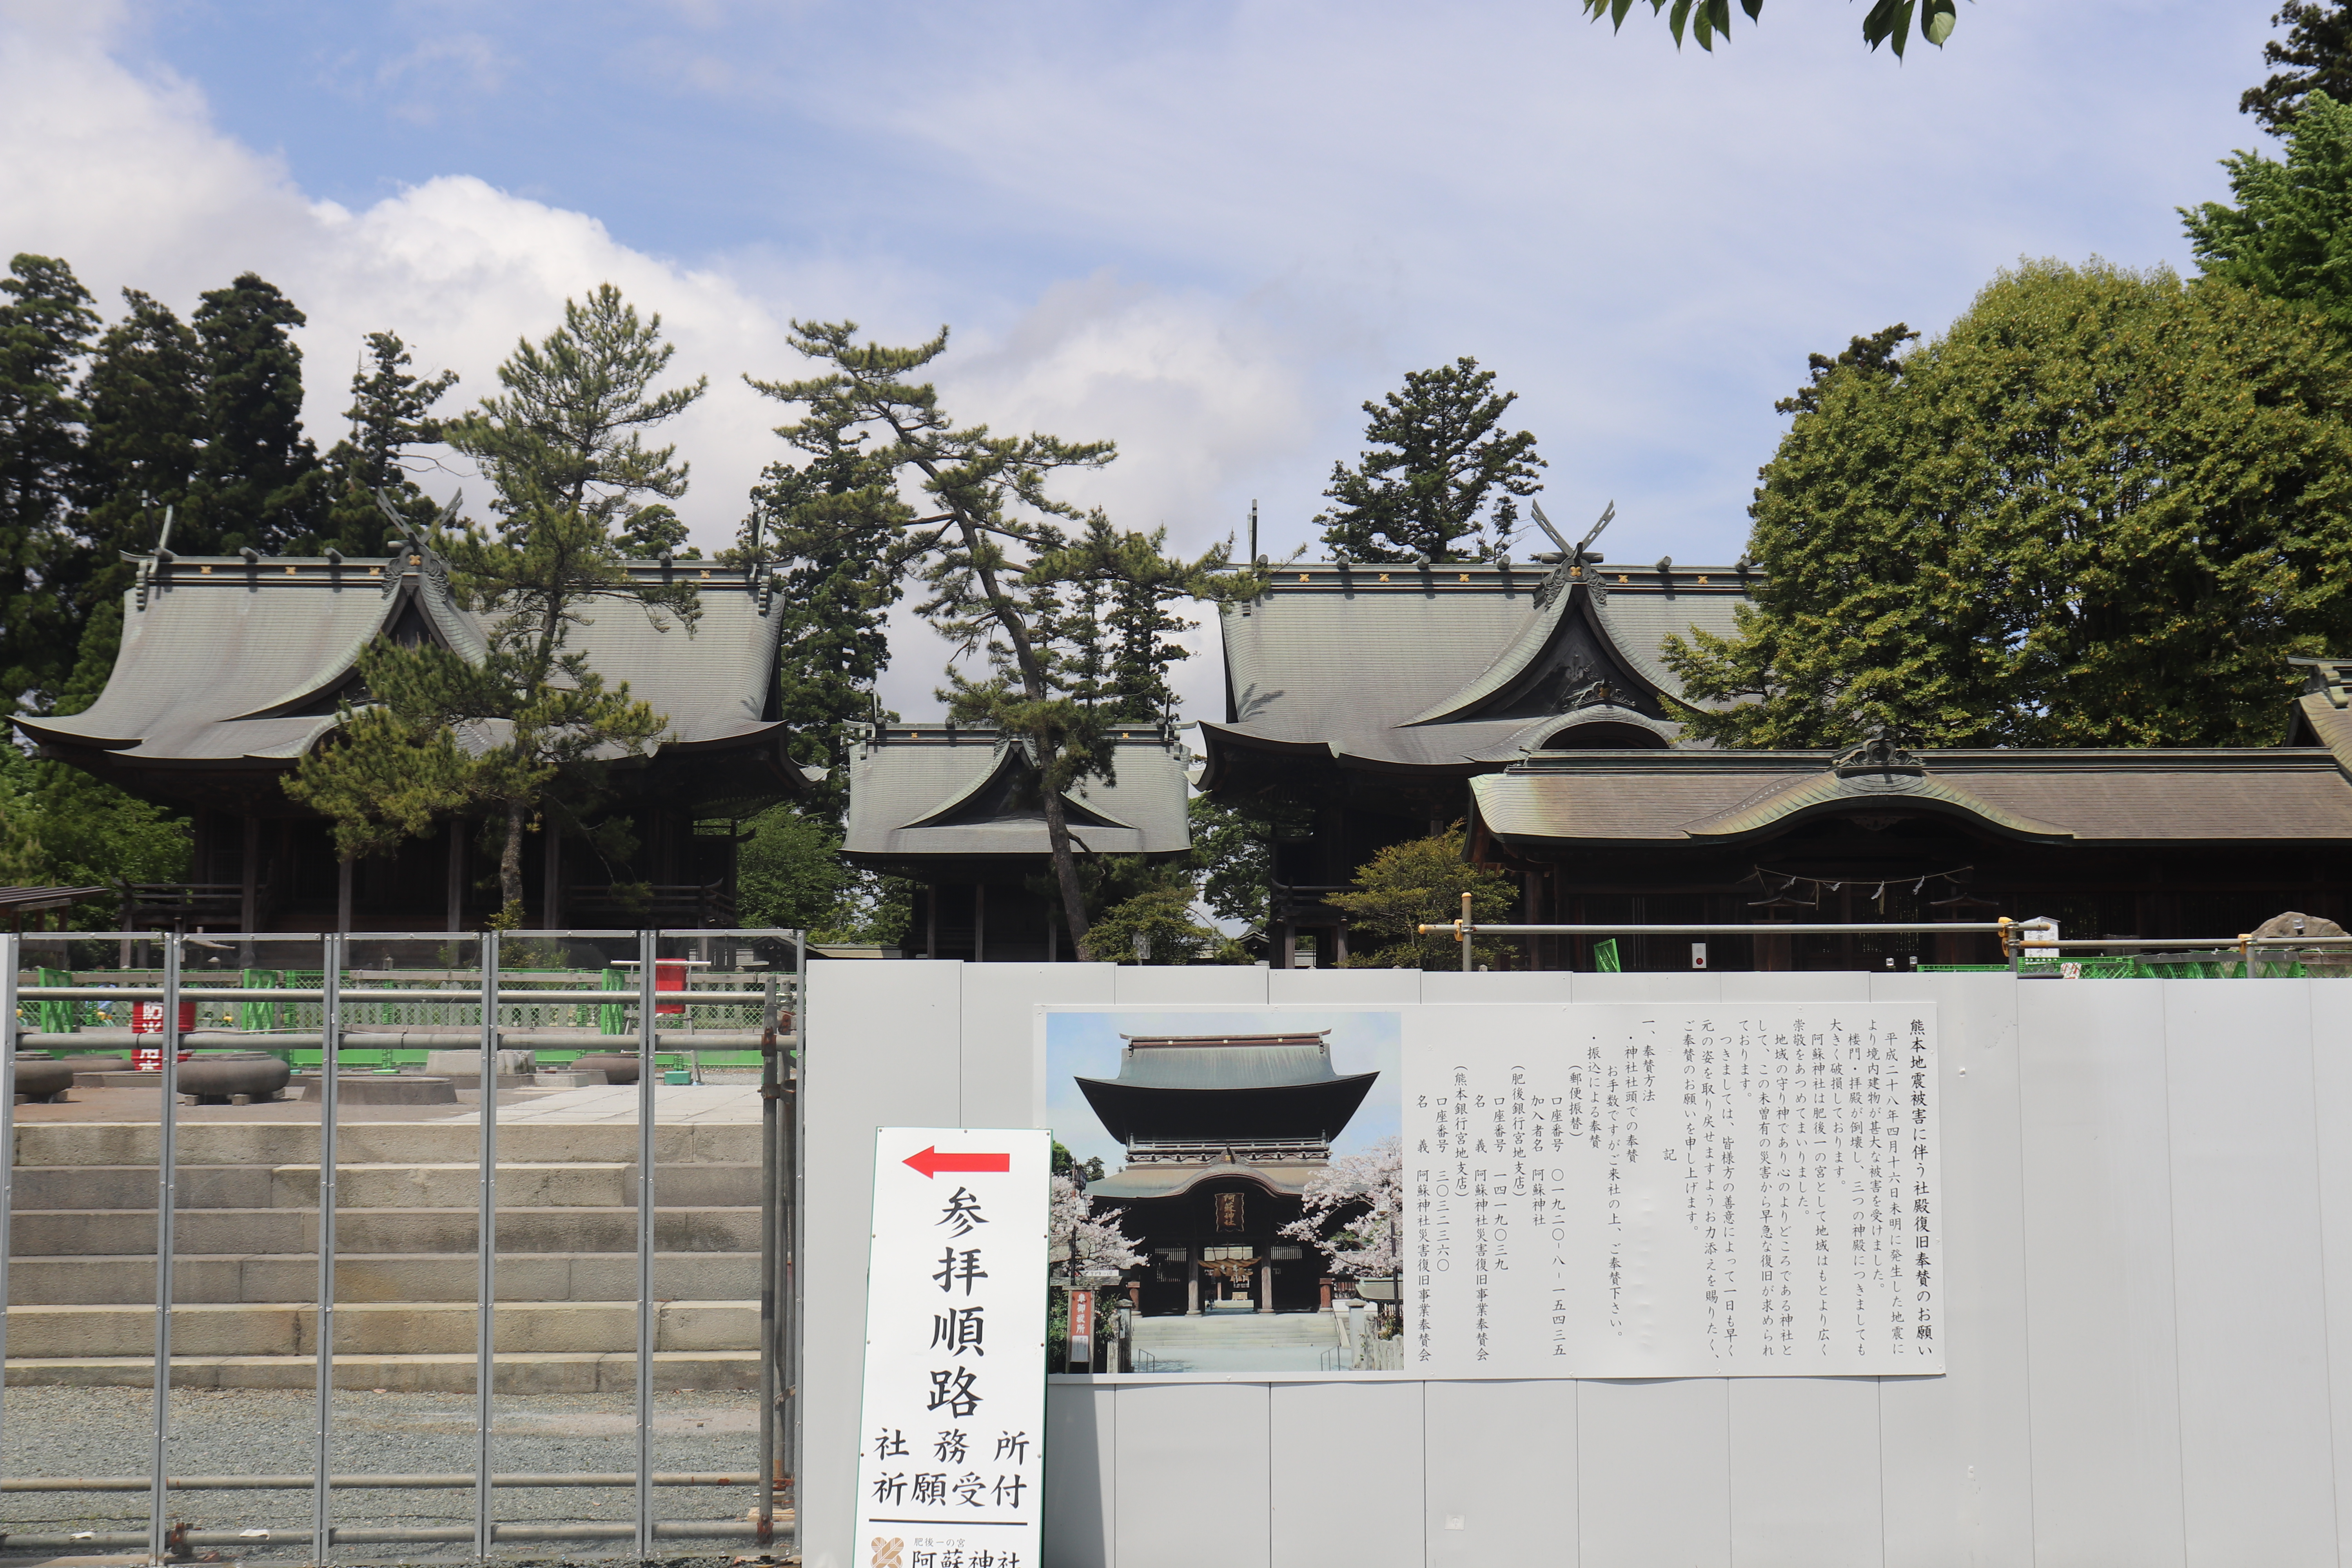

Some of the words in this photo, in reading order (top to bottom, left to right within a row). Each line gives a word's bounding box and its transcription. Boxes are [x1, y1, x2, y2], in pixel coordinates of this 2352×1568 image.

[1531, 1095, 1545, 1152] 加入者名
[1568, 1065, 1583, 1136] （郵便振替）
[1739, 1020, 1751, 1097] ております。
[1793, 1018, 1809, 1214] 崇敬をあつめてまいりました。
[1830, 1018, 1846, 1185] 大きく破損しております。
[1436, 1098, 1449, 1153] 口座番号
[1454, 1066, 1469, 1197] （熊本銀行宮地支店）
[1494, 1097, 1506, 1153] 口座番号
[1511, 1065, 1527, 1196] （肥後銀行宮地支店）
[1551, 1097, 1564, 1152] 口座番号
[1663, 1148, 1677, 1161] 記
[1683, 1020, 1698, 1230] ご奉賛のお願いを申し上げます。
[1701, 1019, 1719, 1358] 元の姿を取り戻せますようお力添えを賜りたく、
[1866, 1019, 1884, 1288] より境内建物が甚大な被害を受けました。
[1910, 1019, 1933, 1355] 熊本地震被害に伴う社殿復旧奉賛のお願い
[1436, 1171, 1450, 1272] 三〇三二三六〇
[1494, 1174, 1508, 1270] 一四一九〇三九
[1532, 1169, 1546, 1226] 阿蘇神社
[1606, 1065, 1622, 1336] お手数ですがご来社の上、ご奉賛下さい。
[1720, 1036, 1737, 1357] つきましては、皆様方の善意によって一日も早く
[1775, 1034, 1793, 1356] 地域の守り神であり心のよりどころである神社と
[1812, 1034, 1829, 1356] 阿蘇神社は肥後一の宮として地域はもとより広く
[1848, 1033, 1866, 1356] 楼門・拝殿が倒壊し、三つの神殿につきましても
[1885, 1032, 1904, 1354] 平成二十八年四月十六日未明に発生した地震に
[926, 1186, 989, 1419] 参拝順路
[1417, 1170, 1431, 1362] 阿蘇神社災害復旧事業奉賛会
[1475, 1169, 1489, 1361] 阿蘇神社災害復旧事業奉賛会
[871, 1471, 1028, 1509] 祈願受付
[874, 1427, 1030, 1466] 社務所
[912, 1548, 1021, 1568] 阿蘇神社
[913, 1537, 965, 1548] 肥後一の宮
